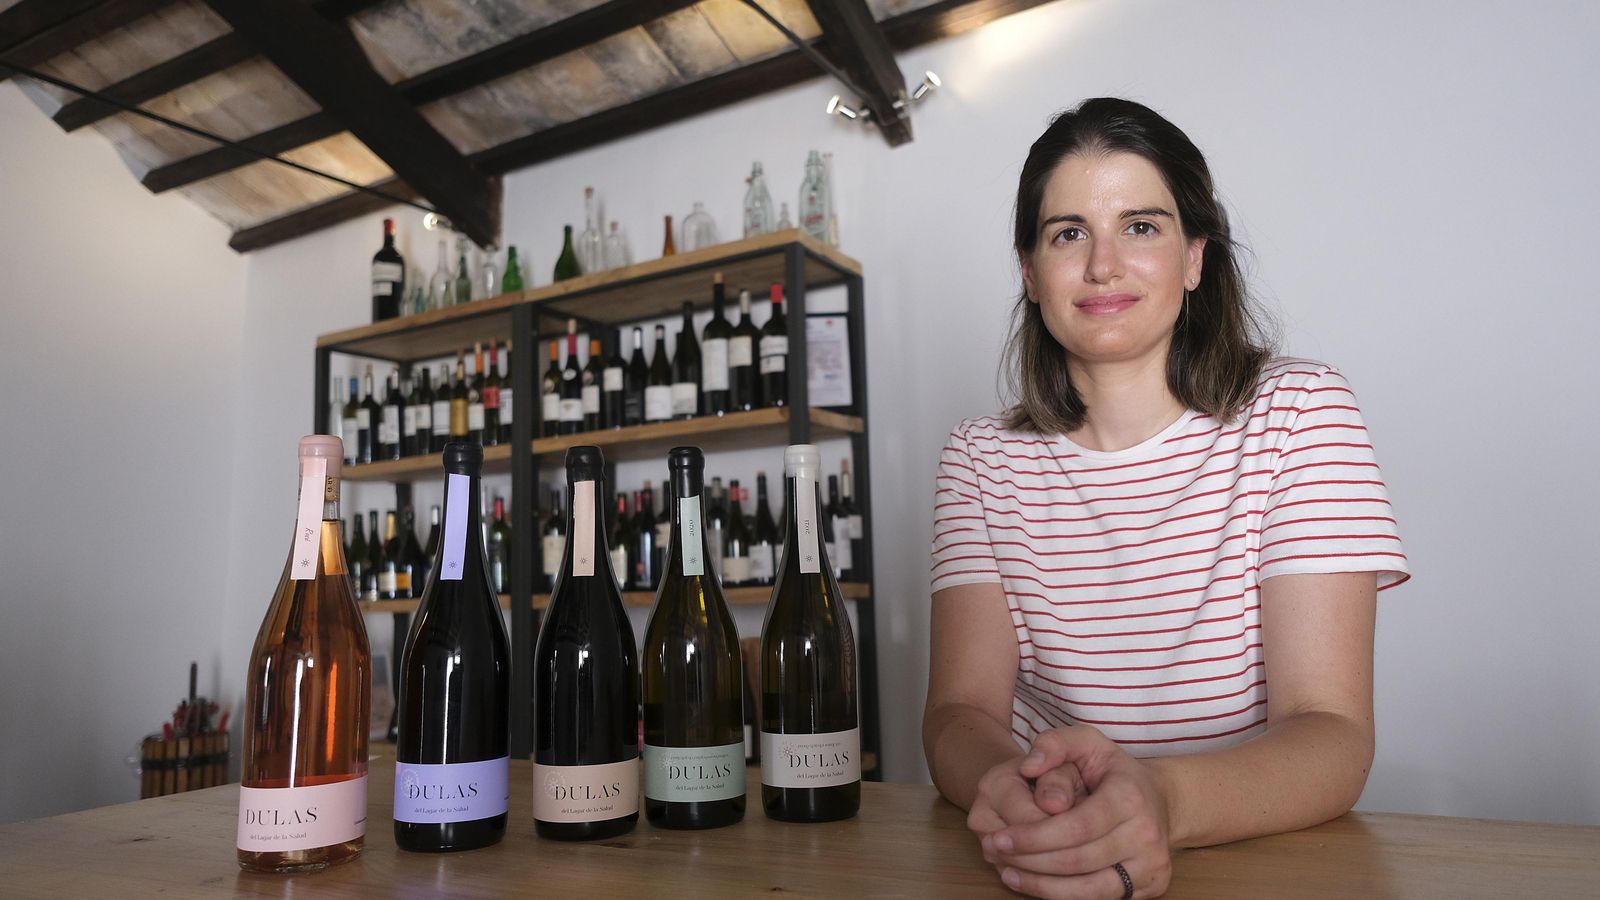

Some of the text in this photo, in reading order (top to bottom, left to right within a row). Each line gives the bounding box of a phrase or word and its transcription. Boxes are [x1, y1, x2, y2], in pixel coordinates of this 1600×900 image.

[790, 751, 849, 768] DULAS
[670, 763, 731, 780] DULAS
[409, 782, 478, 800] DULAS
[555, 782, 620, 800] DULAS
[246, 806, 317, 825] DULAS
